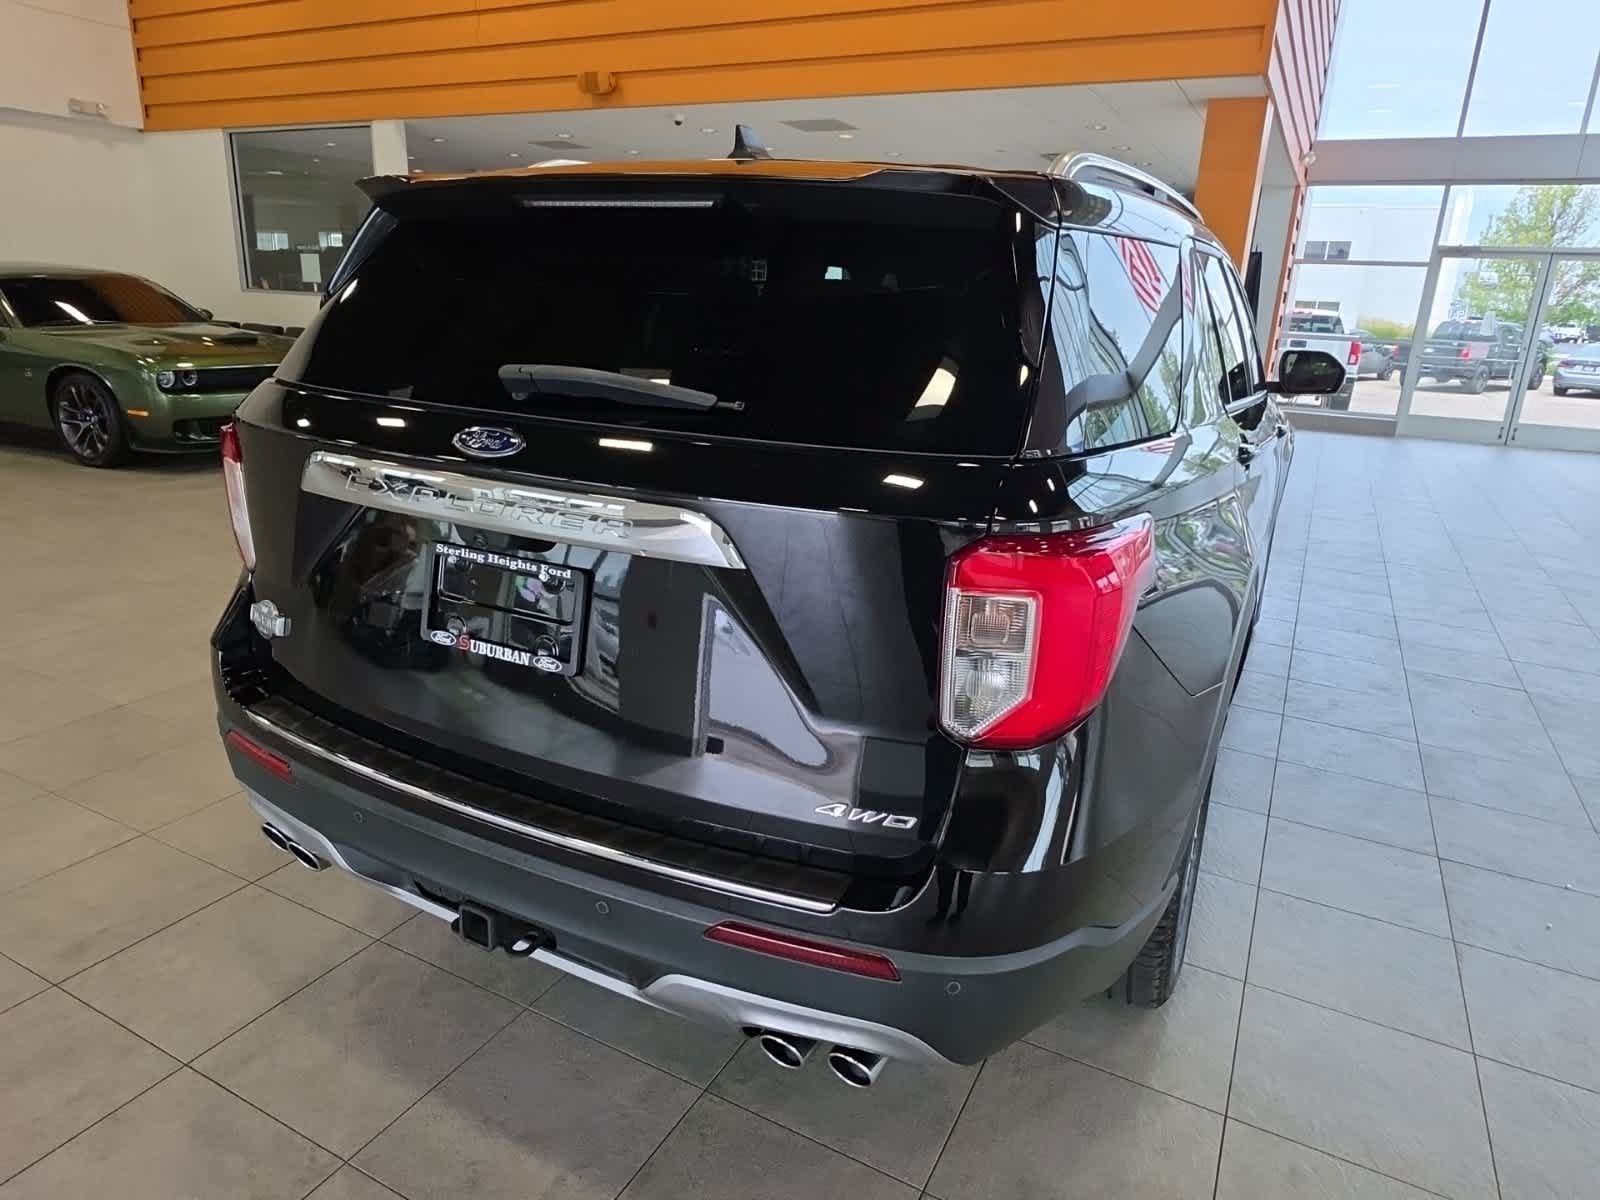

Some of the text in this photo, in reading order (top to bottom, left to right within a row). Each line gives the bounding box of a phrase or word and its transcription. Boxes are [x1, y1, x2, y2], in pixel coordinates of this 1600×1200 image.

[460, 429, 511, 452] Ford
[436, 543, 572, 580] Sterling Heights Ford
[459, 634, 531, 666] SUBURBAN
[815, 803, 918, 829] 4WD
